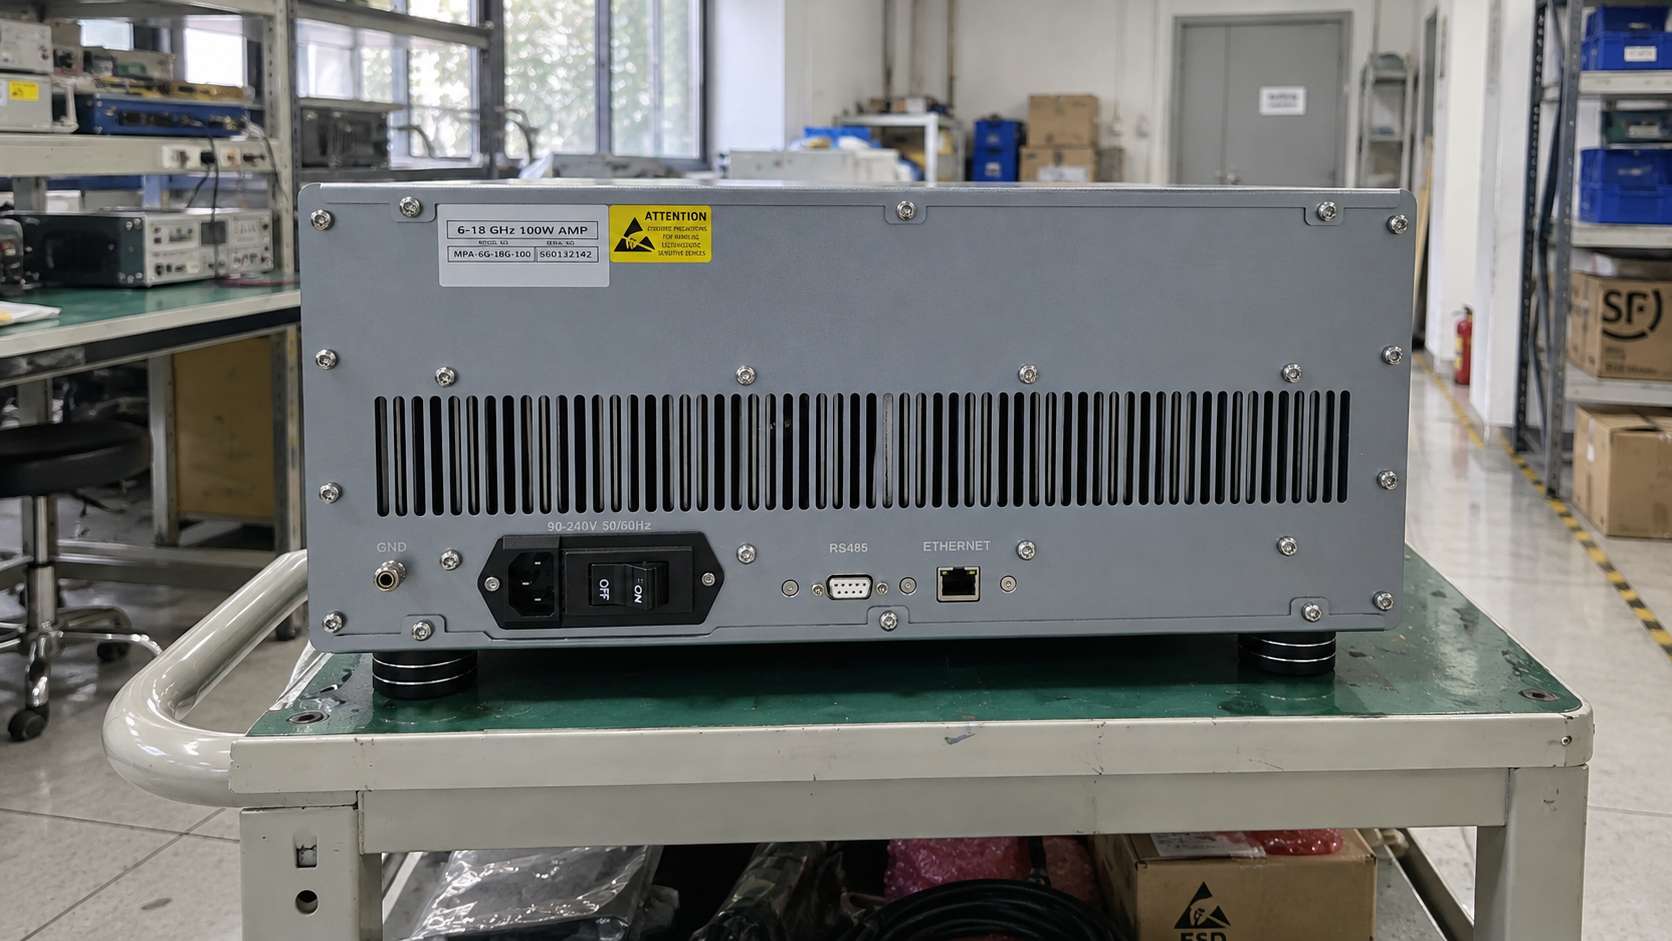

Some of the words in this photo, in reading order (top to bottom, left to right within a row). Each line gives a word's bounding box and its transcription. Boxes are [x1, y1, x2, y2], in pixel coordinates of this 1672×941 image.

[645, 211, 707, 221] ATTENTION
[457, 225, 486, 235] 6-18
[489, 225, 515, 235] GHz
[520, 226, 555, 235] 100W
[558, 226, 588, 235] AMP
[547, 521, 598, 532] 90-240V
[602, 520, 652, 531] 50/60Hz
[376, 541, 407, 553] GND
[829, 543, 868, 553] RS485
[923, 540, 991, 552] ETHERNET
[599, 579, 610, 601] OFF
[634, 585, 643, 604] ON
